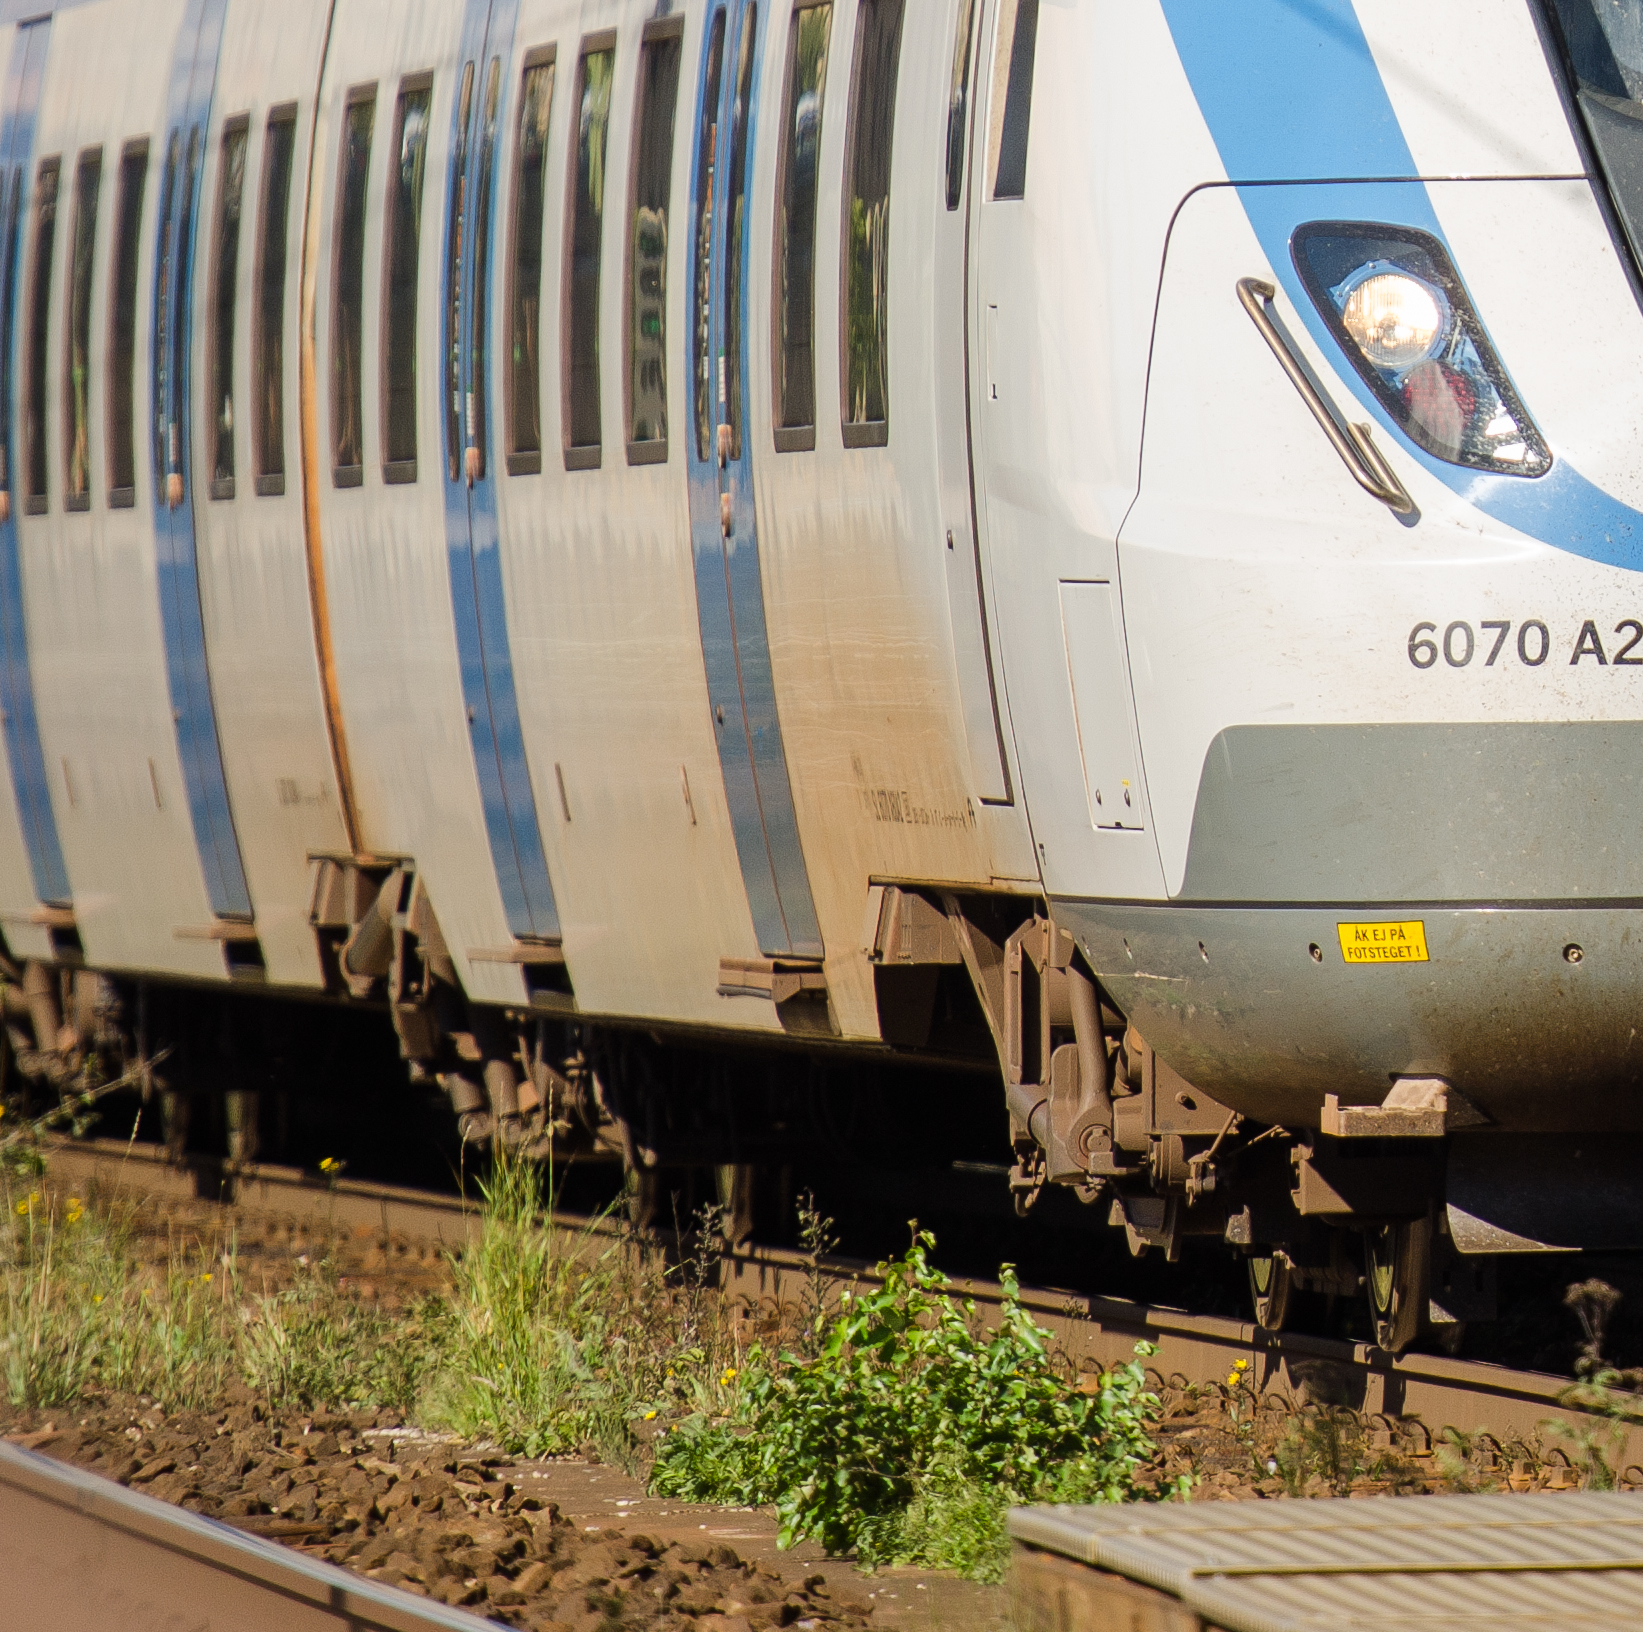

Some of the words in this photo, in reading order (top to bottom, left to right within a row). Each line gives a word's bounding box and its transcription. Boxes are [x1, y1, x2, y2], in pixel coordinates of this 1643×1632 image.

[1407, 619, 1550, 669] 6070
[1355, 925, 1370, 942] ÅK
[1373, 928, 1386, 941] EJ
[1390, 924, 1406, 941] PÅ
[1347, 945, 1412, 959] FOTSTEGET
